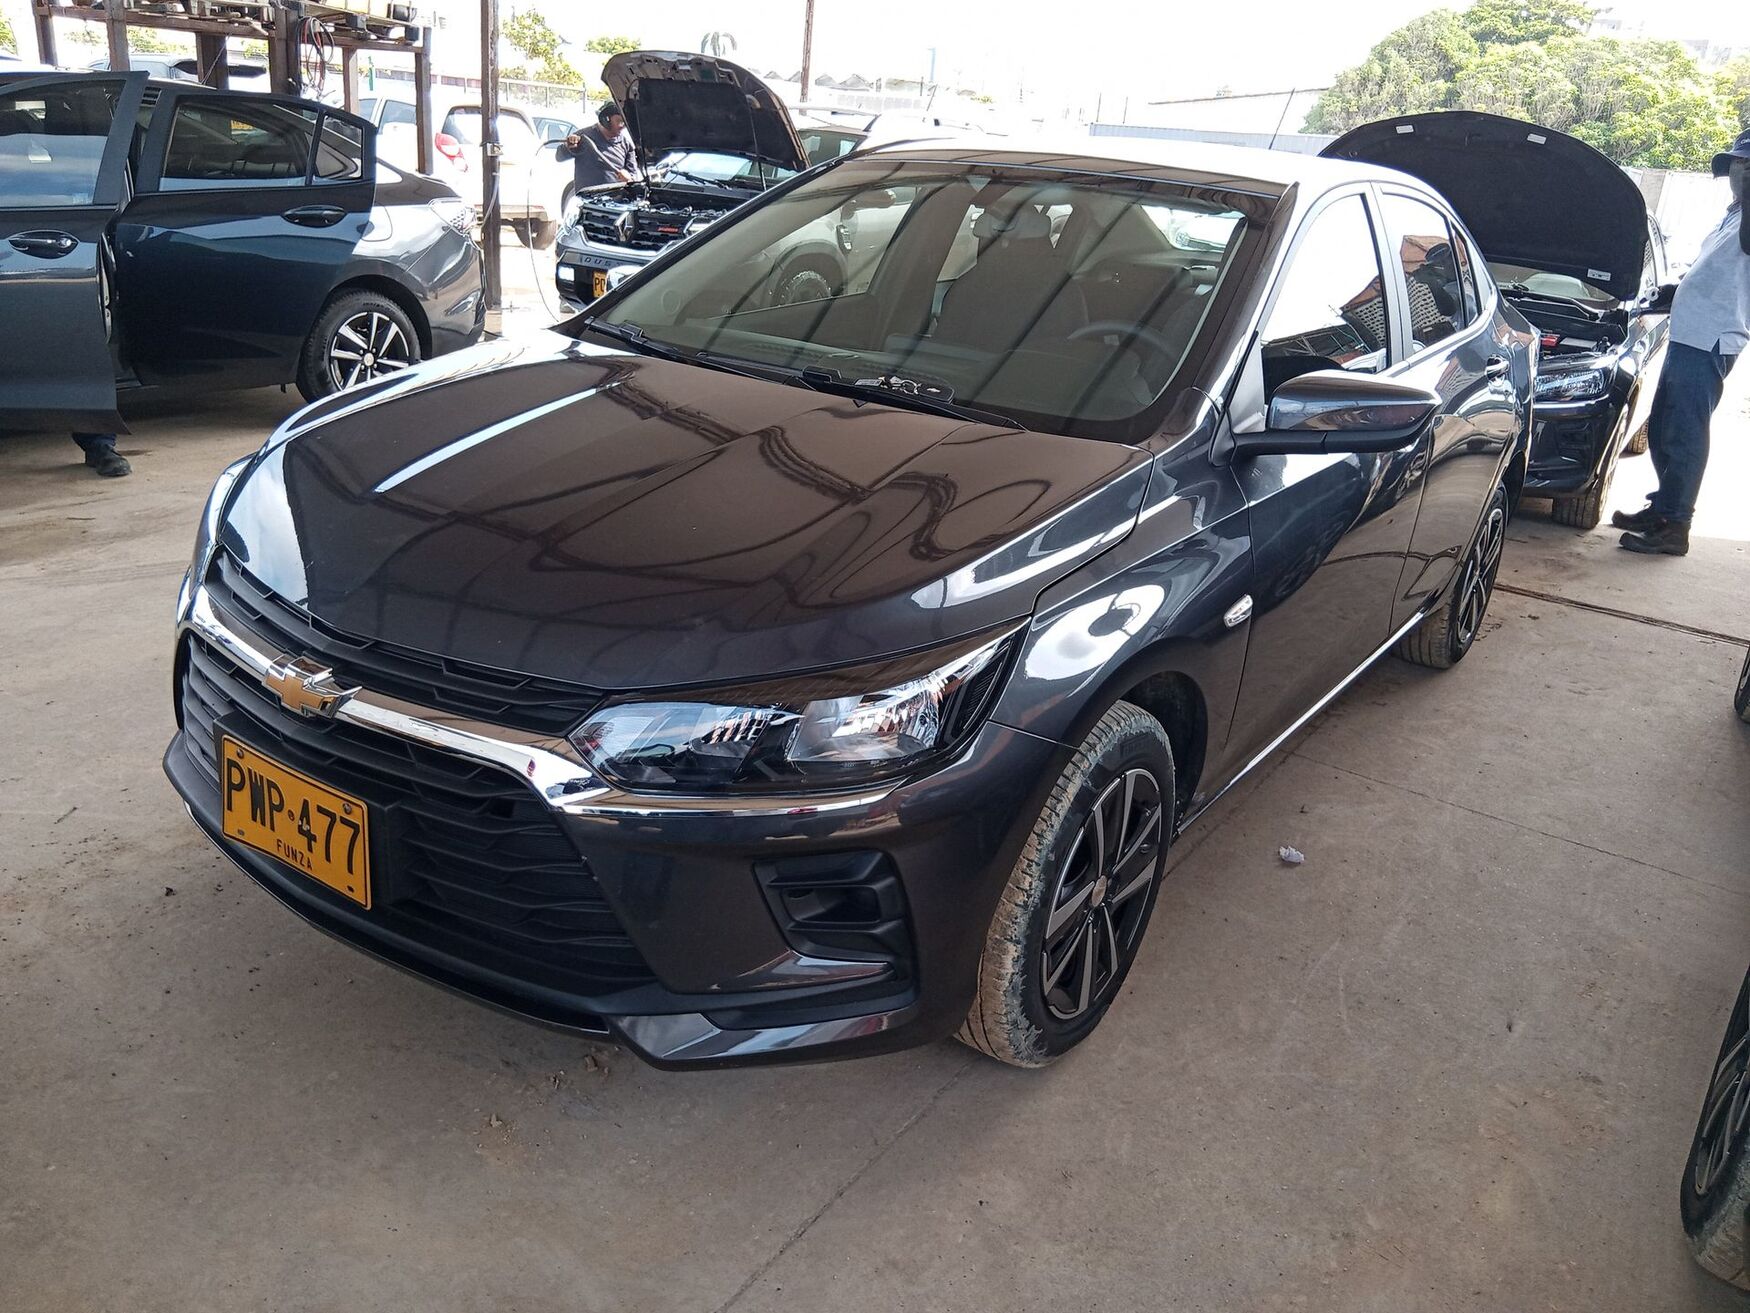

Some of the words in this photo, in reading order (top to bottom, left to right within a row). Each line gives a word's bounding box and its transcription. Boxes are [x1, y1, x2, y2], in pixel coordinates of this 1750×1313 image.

[226, 757, 285, 832] PWP
[298, 798, 361, 875] 477
[276, 838, 313, 871] FUNZA
